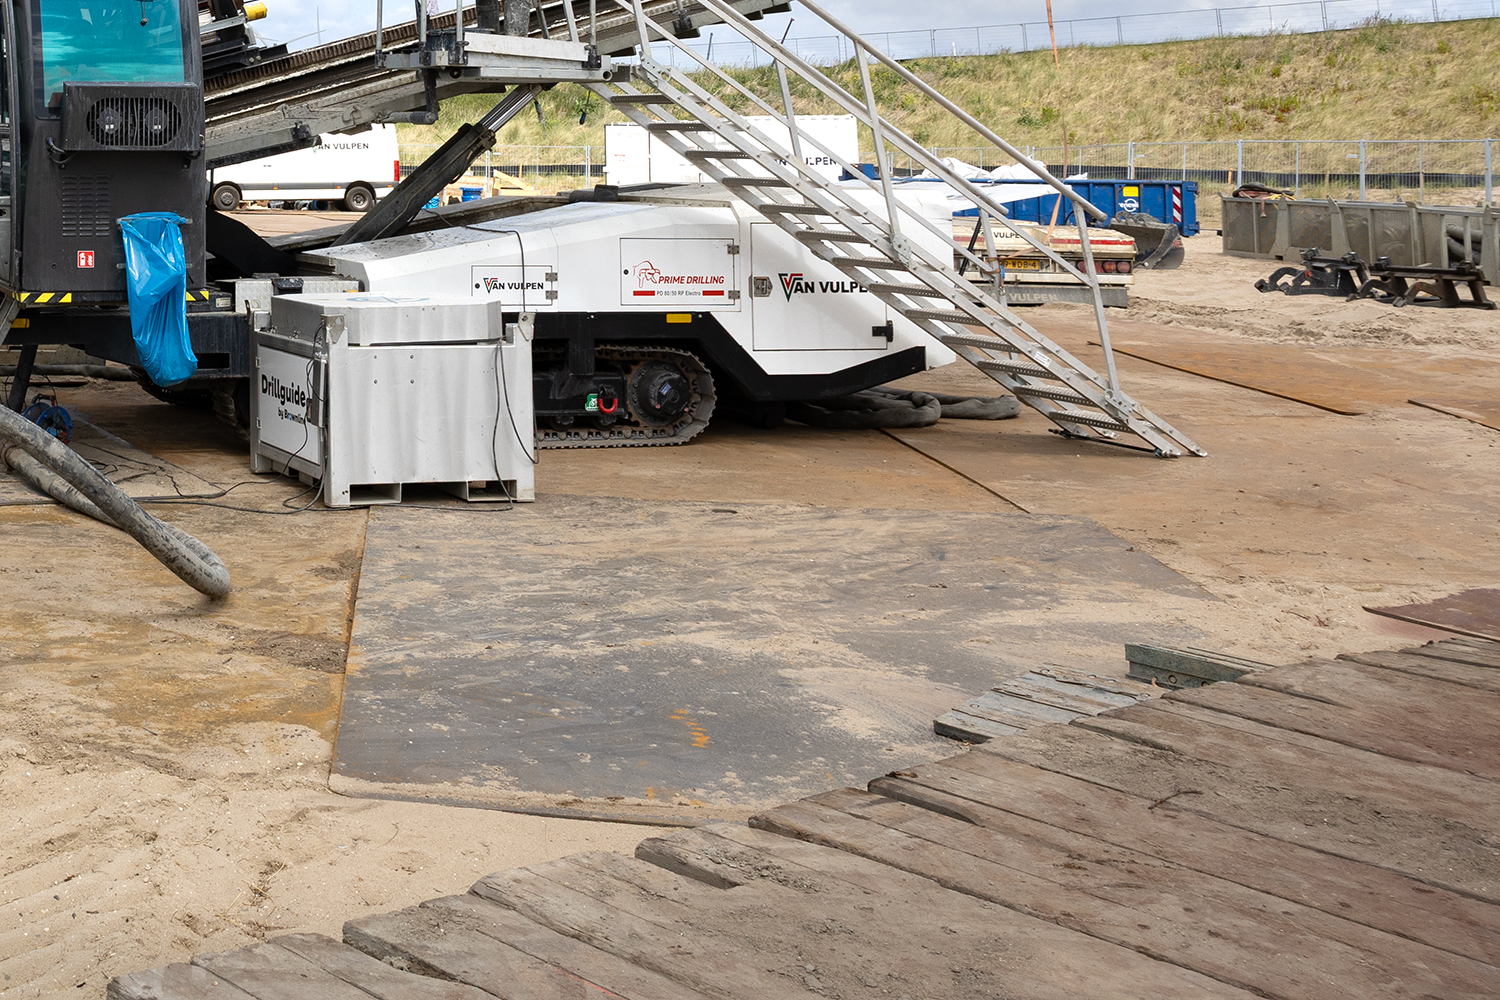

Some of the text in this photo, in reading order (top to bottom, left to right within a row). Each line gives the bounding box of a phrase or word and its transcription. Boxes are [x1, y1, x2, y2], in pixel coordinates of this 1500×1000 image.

[993, 231, 1020, 239] VULPE
[483, 278, 544, 294] VAN VULPEN
[658, 275, 725, 284] PRIME DRILLING
[778, 273, 868, 302] VAN VULPE
[1008, 292, 1058, 302] VULPEN
[261, 374, 306, 407] Drillguide
